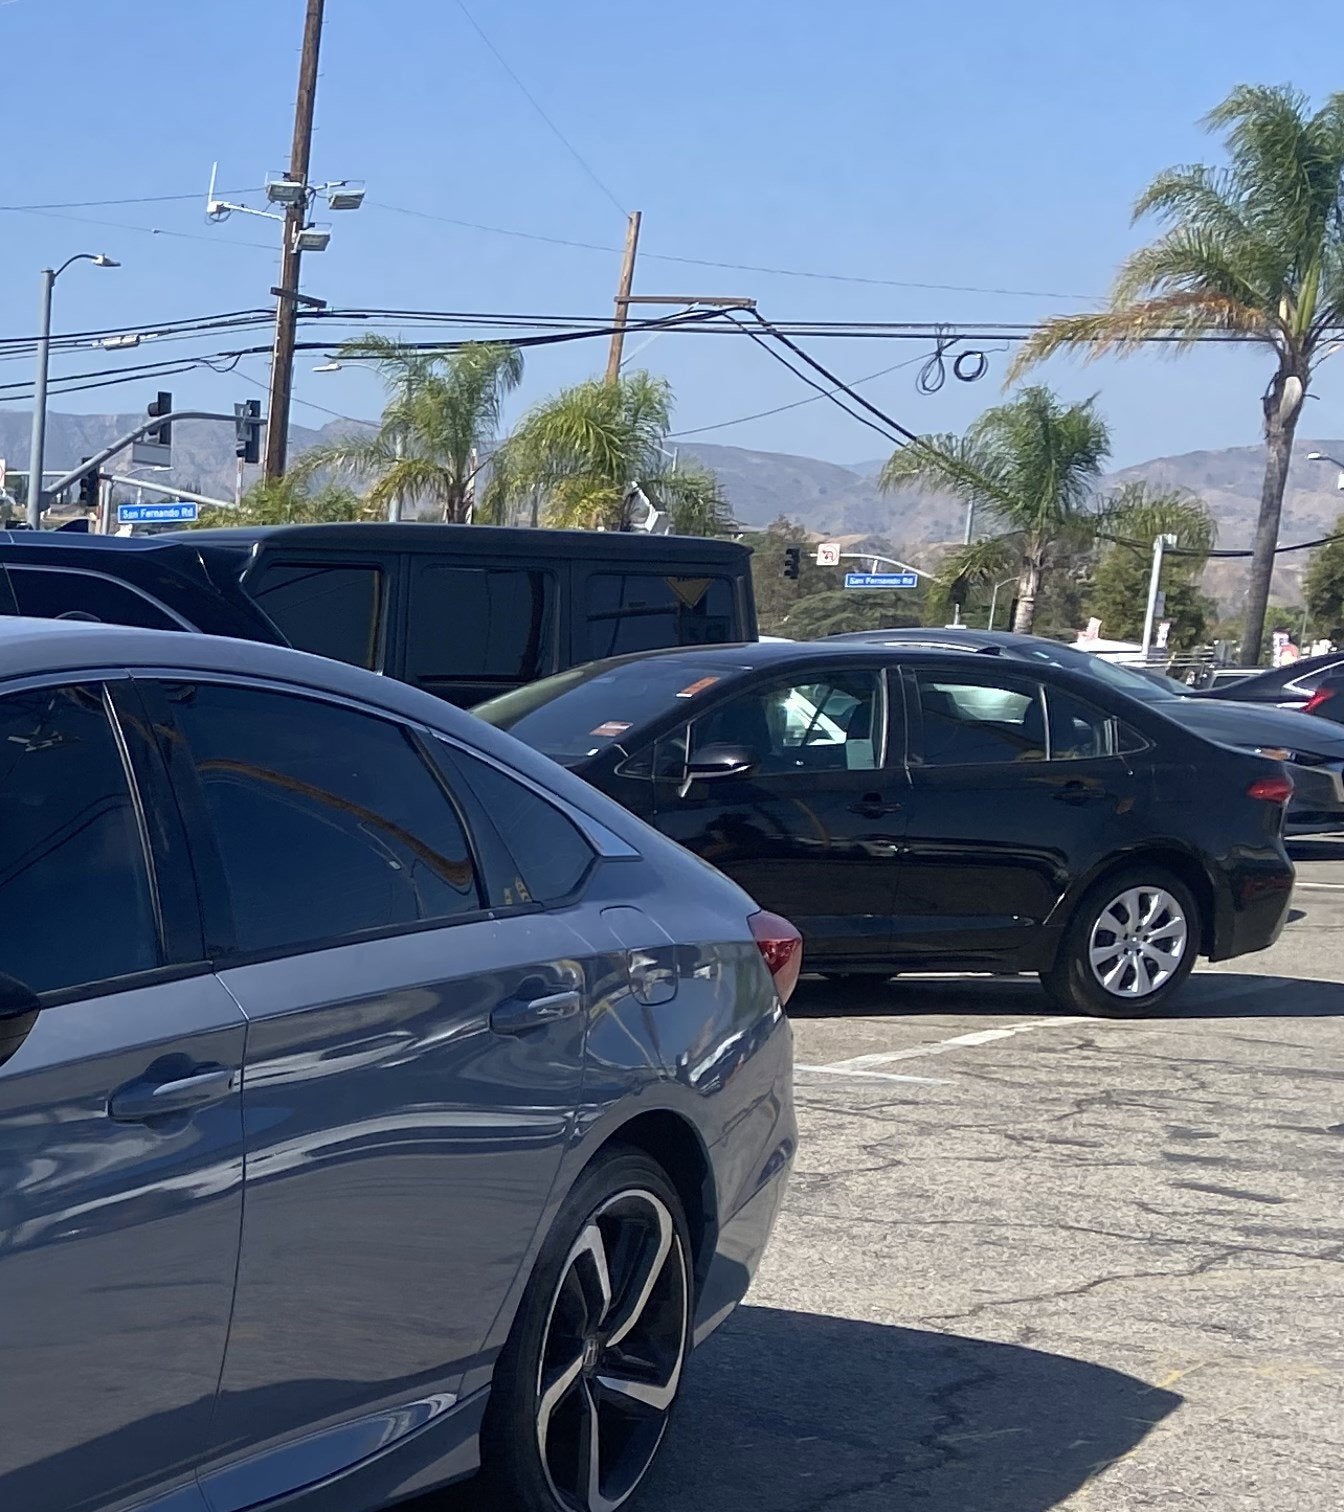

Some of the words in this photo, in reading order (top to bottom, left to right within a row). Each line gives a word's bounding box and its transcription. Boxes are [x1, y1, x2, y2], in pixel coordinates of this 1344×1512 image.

[122, 509, 138, 519] San
[140, 508, 179, 518] Fernando
[181, 507, 193, 517] Rd
